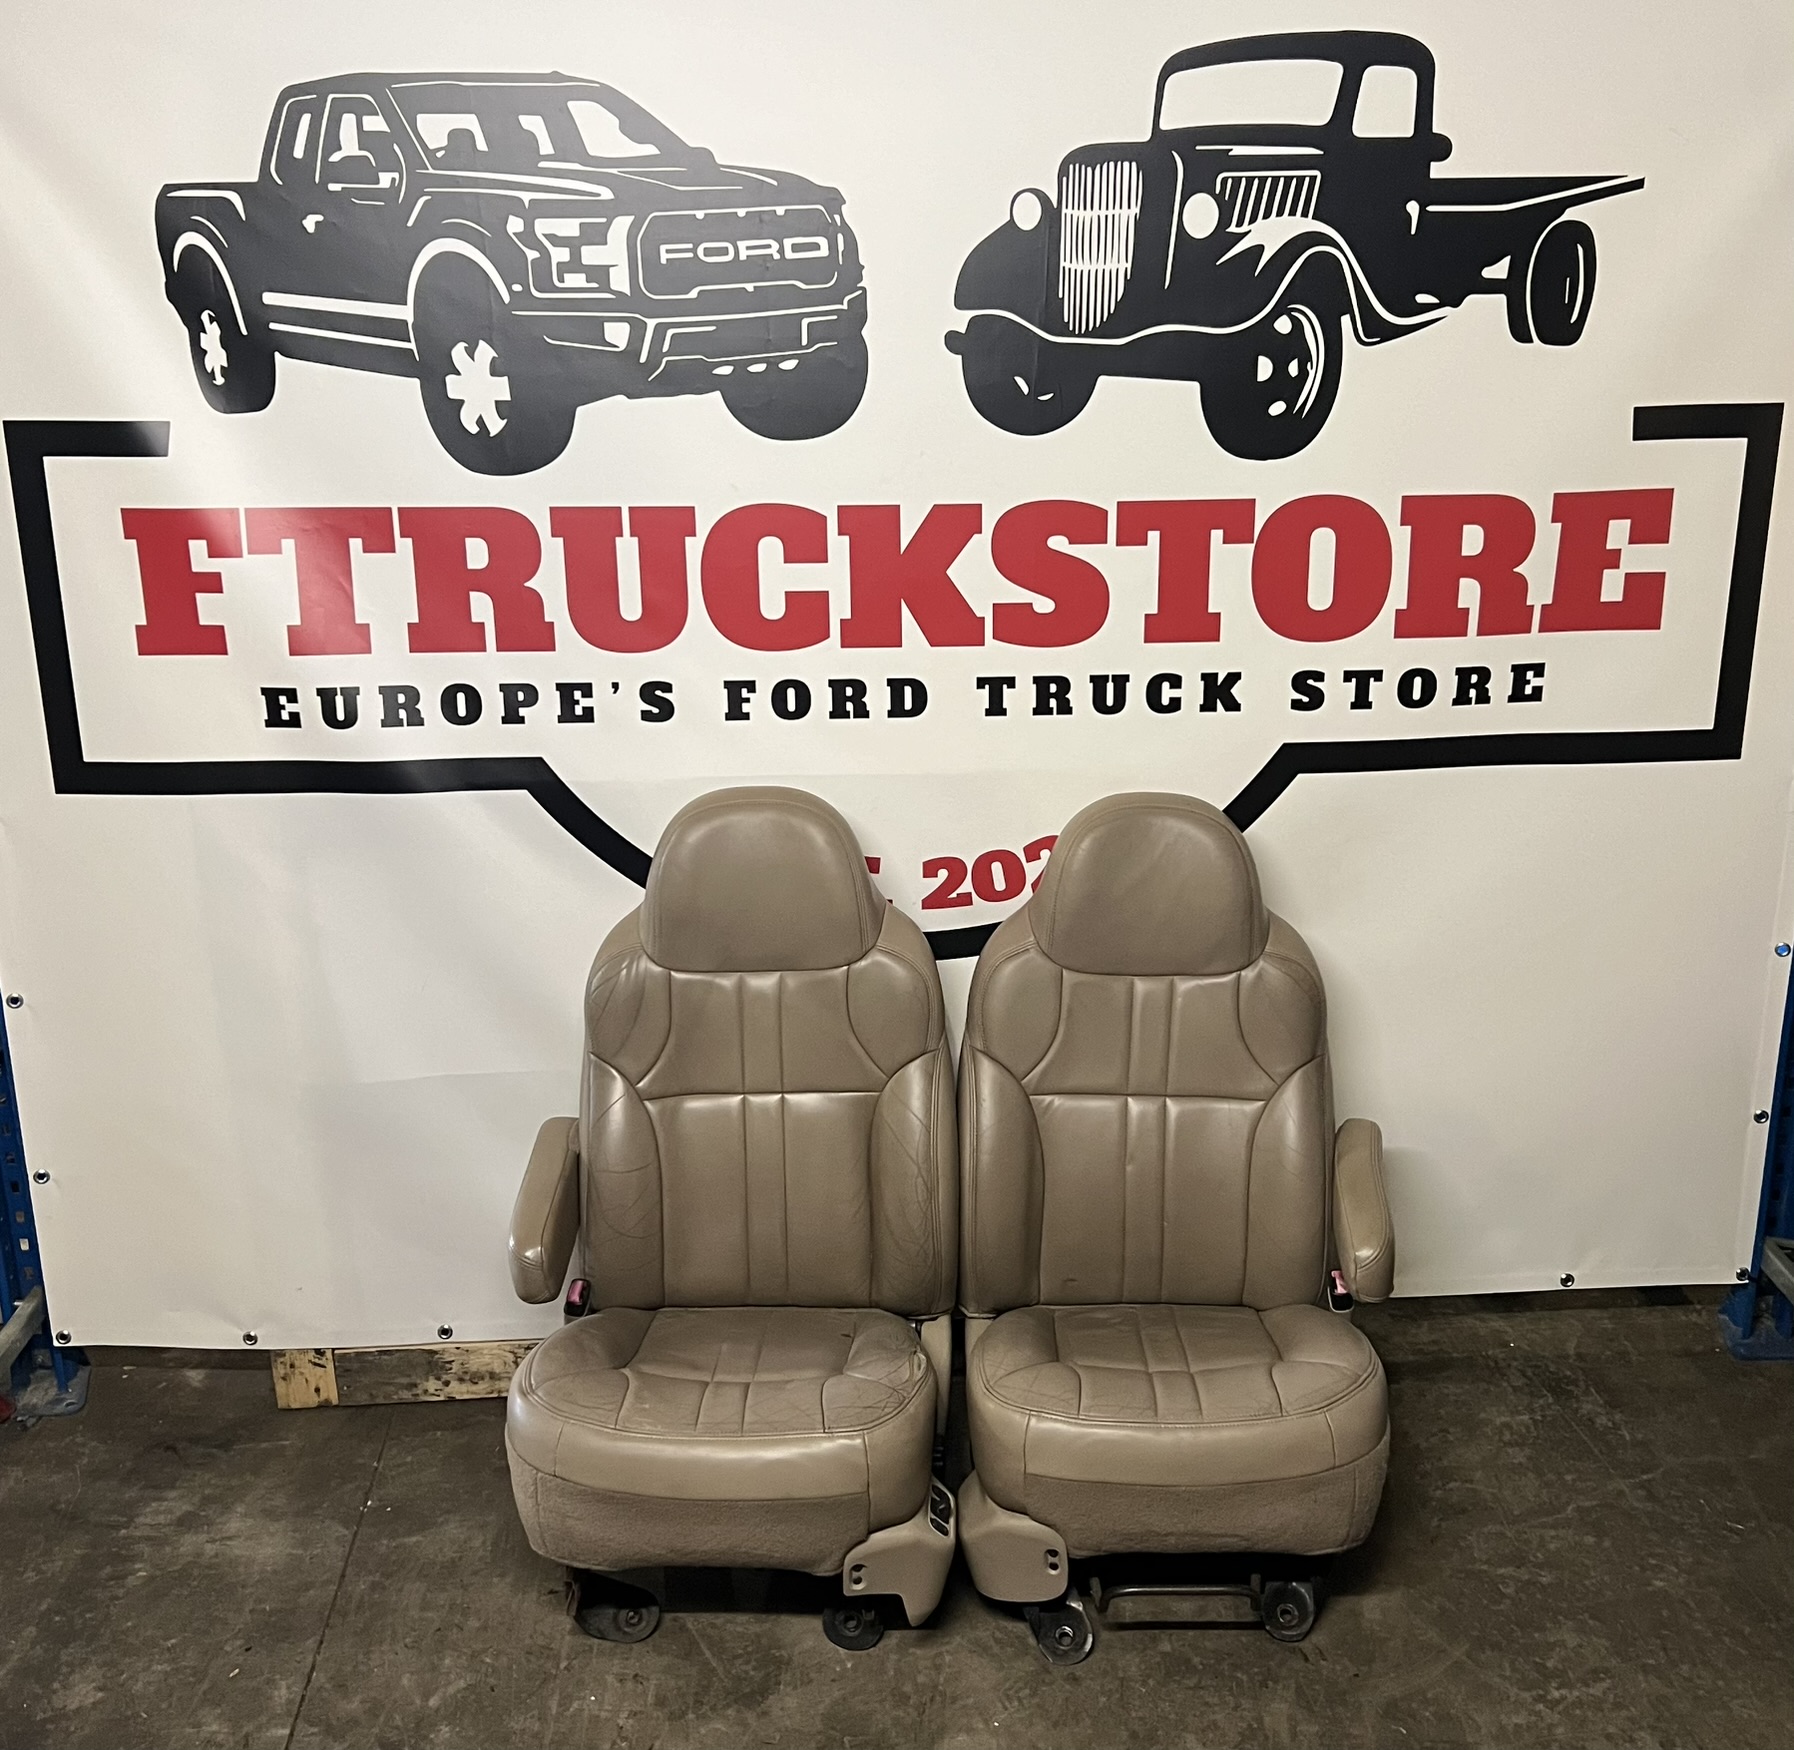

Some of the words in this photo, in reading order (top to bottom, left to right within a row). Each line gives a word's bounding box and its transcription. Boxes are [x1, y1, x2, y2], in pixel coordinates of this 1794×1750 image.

[659, 235, 829, 265] FORD
[121, 488, 1674, 657] FTRUCKSTORE
[261, 681, 675, 730] EUROPE'S
[723, 677, 928, 722] FORD
[976, 671, 1242, 717] TRUCK
[1290, 662, 1546, 712] STORE
